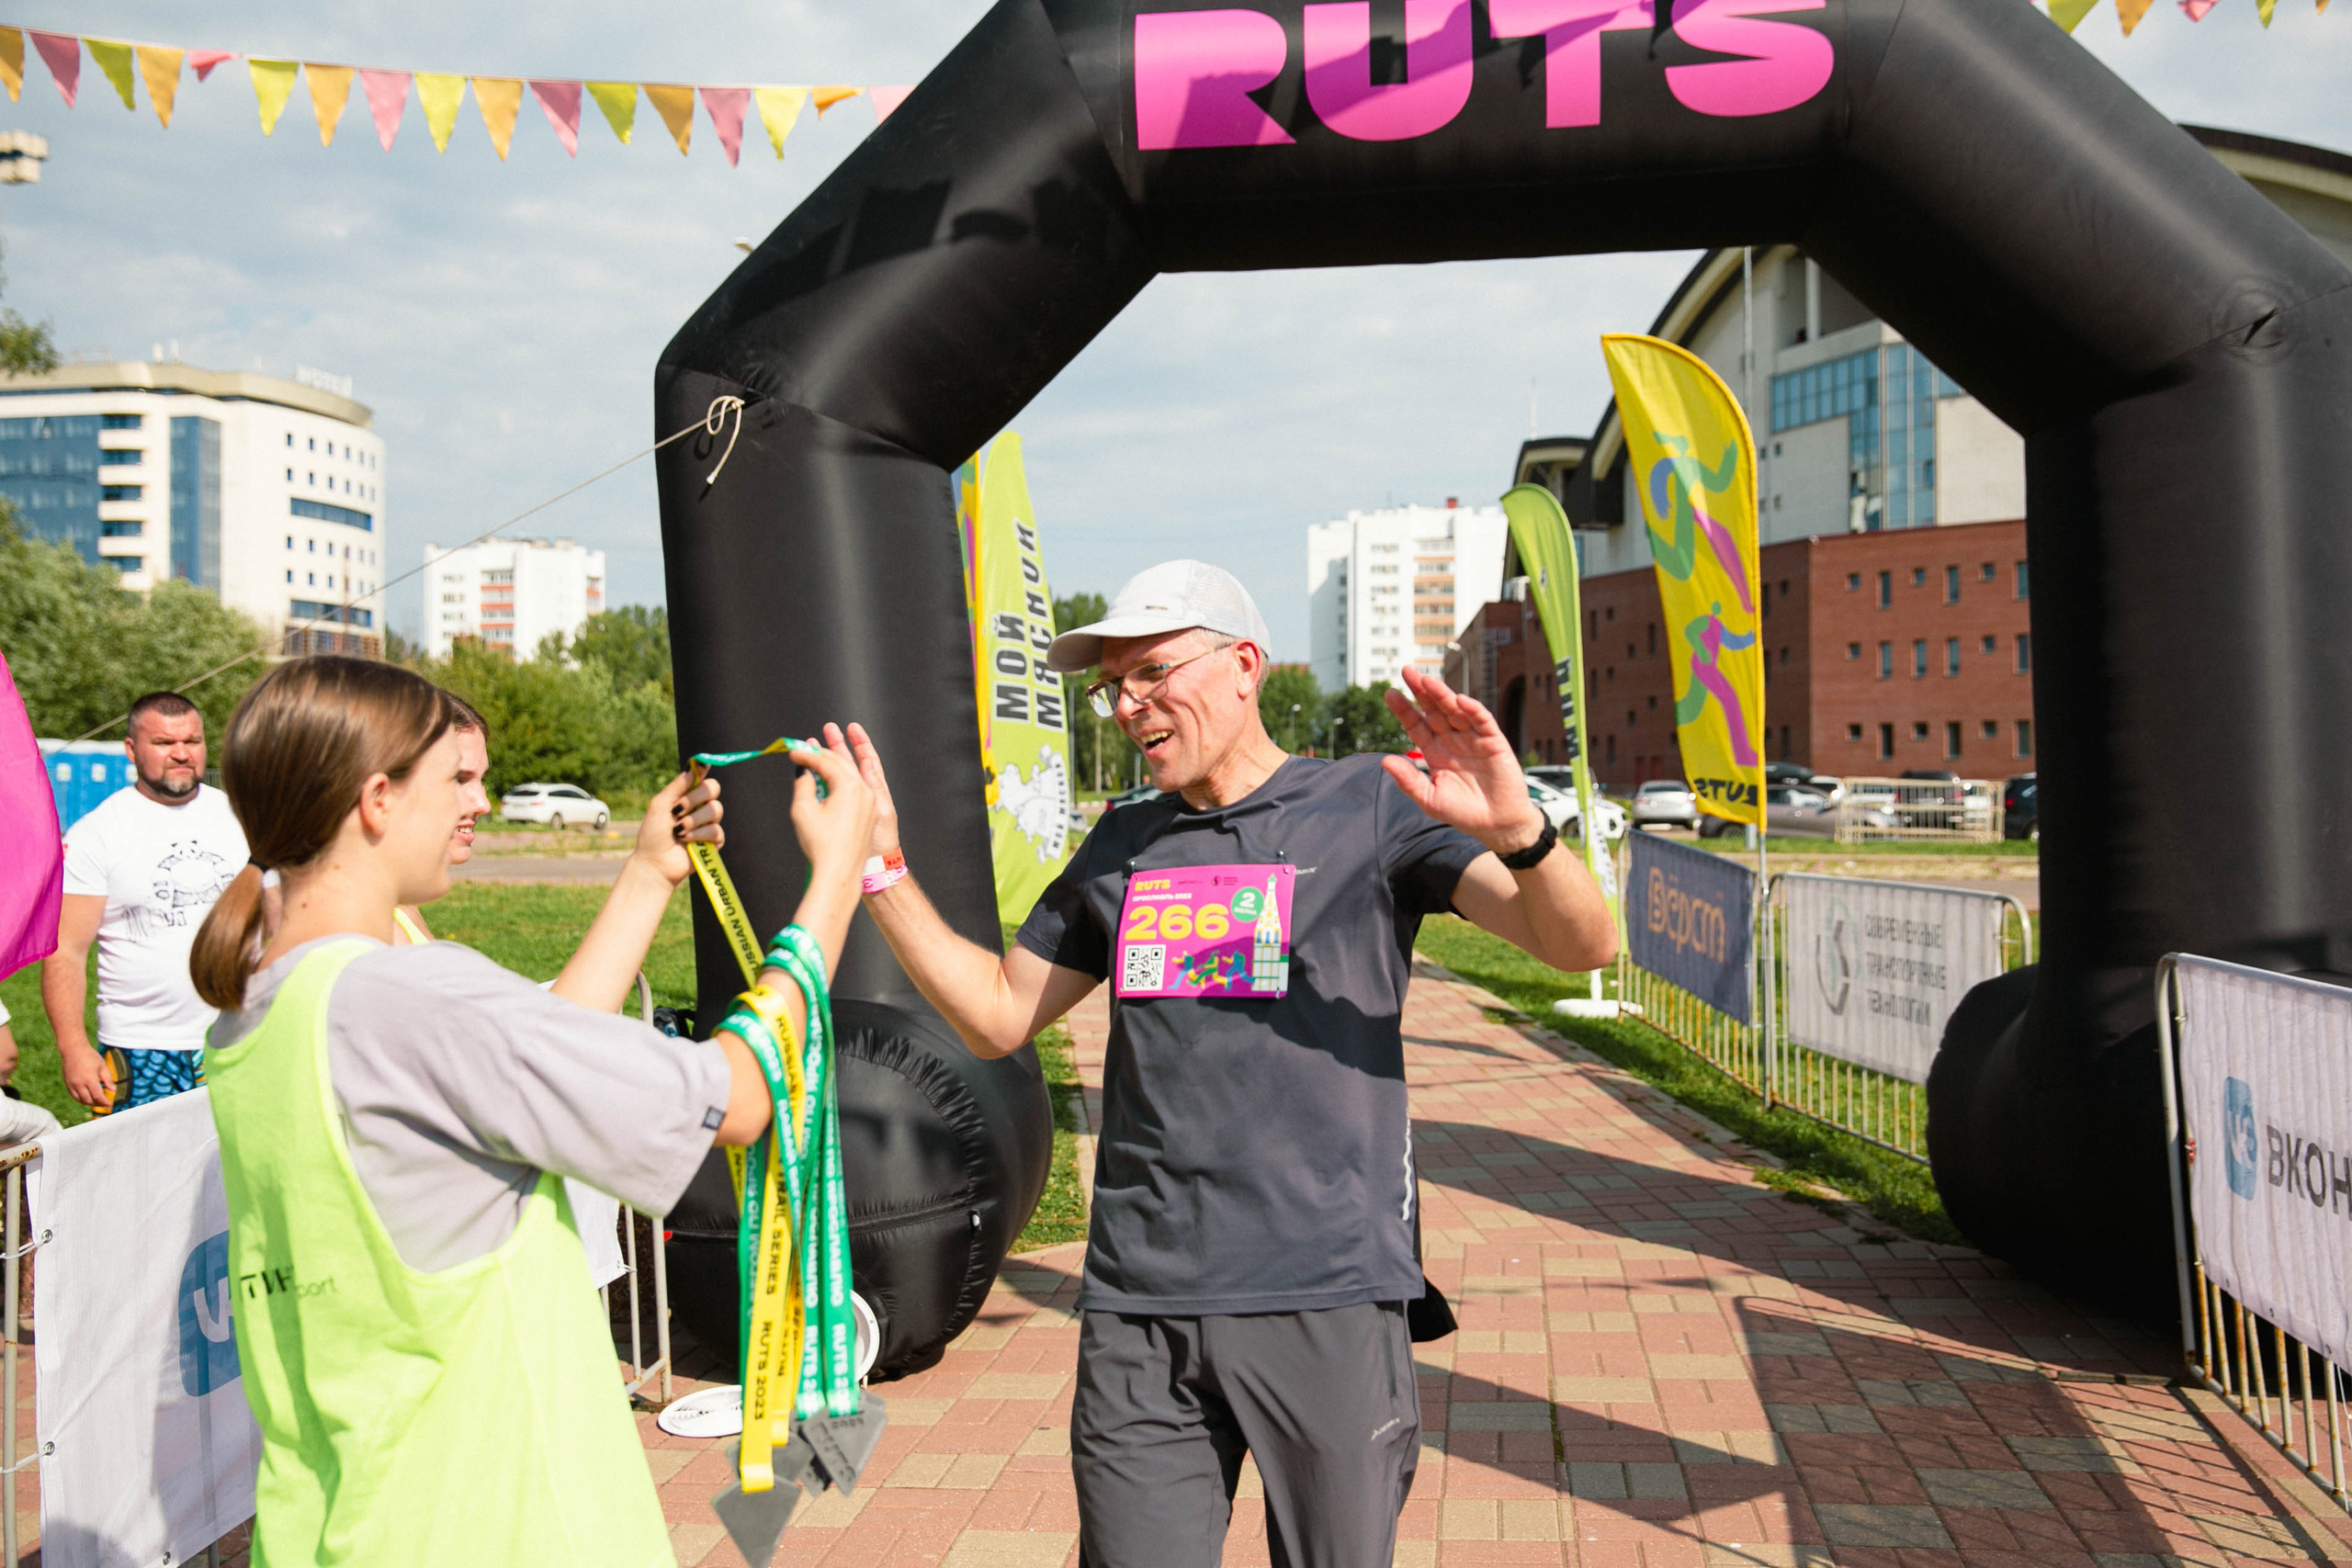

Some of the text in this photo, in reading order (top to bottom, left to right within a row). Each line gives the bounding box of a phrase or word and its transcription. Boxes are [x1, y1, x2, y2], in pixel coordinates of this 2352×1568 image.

[1134, 0, 1836, 151] RUTS
[992, 613, 1029, 722] МОЙ
[708, 868, 736, 916] URBAN
[1134, 878, 1171, 892] RUTS
[1239, 892, 1256, 908] 2
[729, 919, 762, 973] USSIAN
[1125, 903, 1230, 941] 266
[766, 1230, 784, 1296] SERIES
[826, 1179, 844, 1307] ЯРОСЛАВЛЮ
[753, 1320, 774, 1421] RUTS 2023
[804, 1325, 819, 1377] RUTS
[831, 1323, 848, 1374] RUTS
